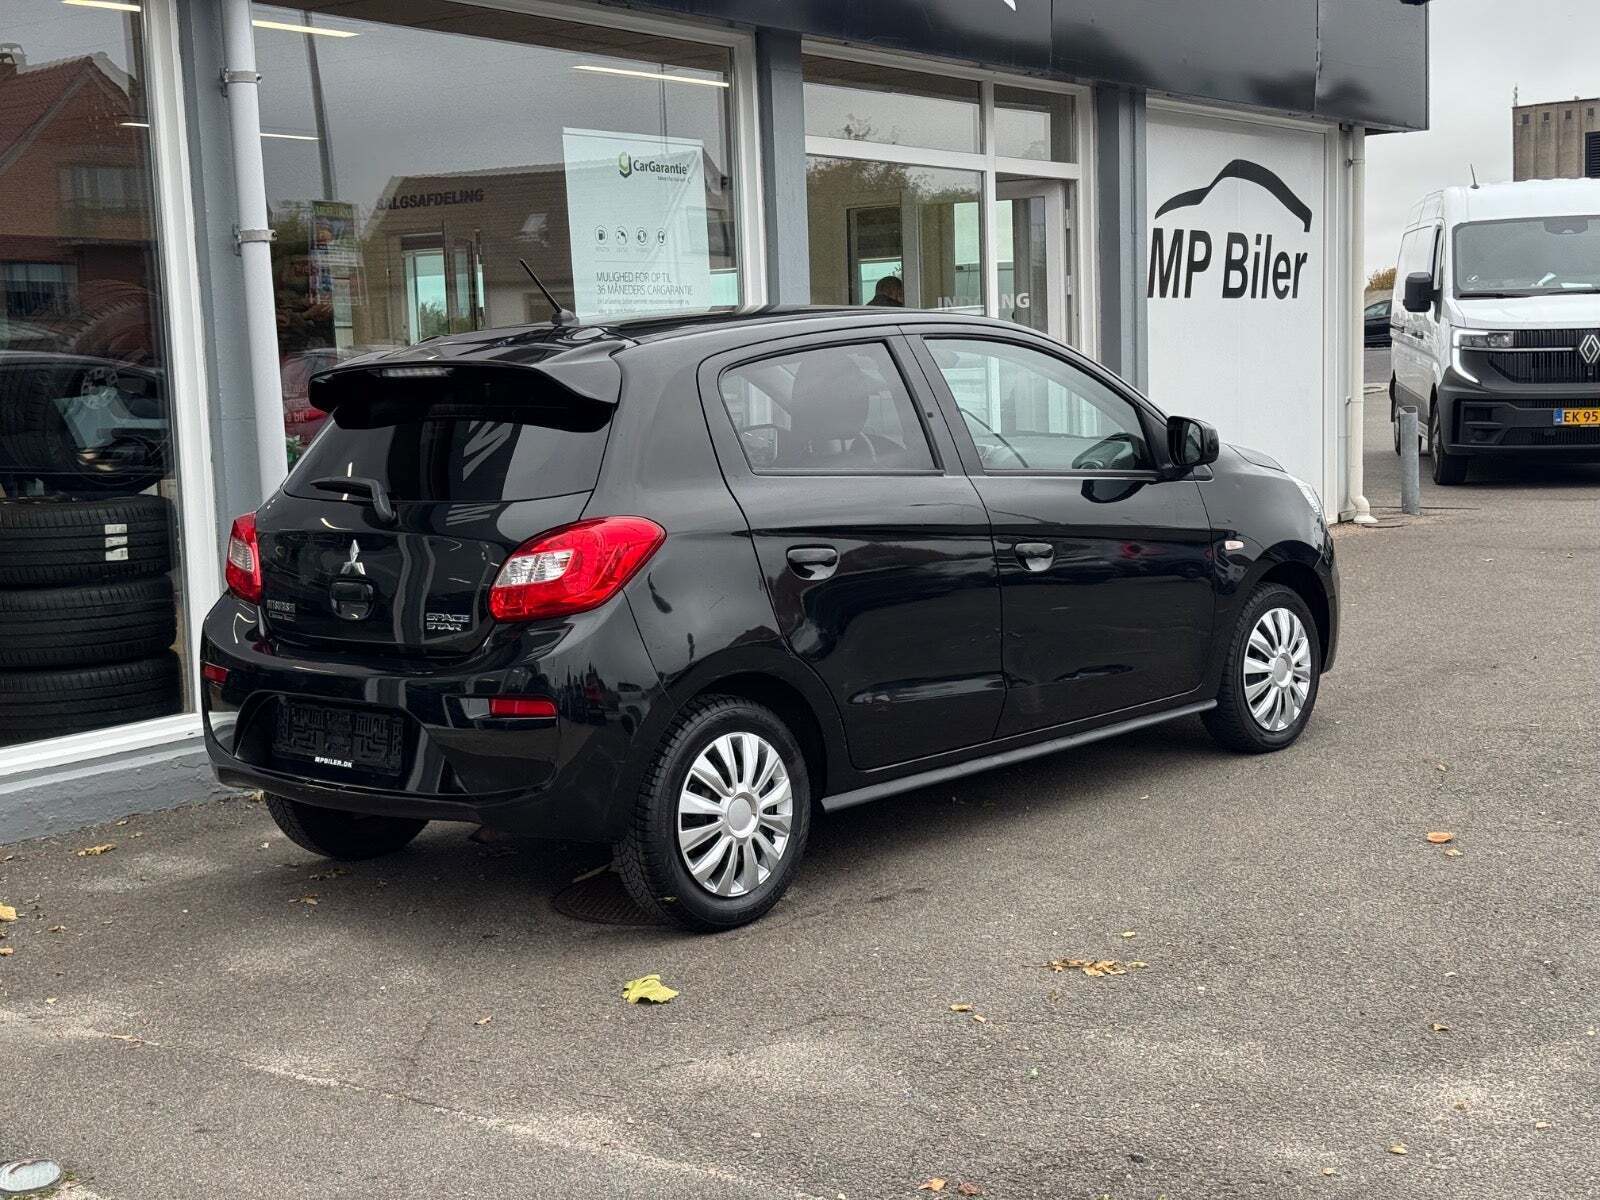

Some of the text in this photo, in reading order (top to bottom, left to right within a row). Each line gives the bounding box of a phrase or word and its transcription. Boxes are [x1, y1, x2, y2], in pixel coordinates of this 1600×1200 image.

[633, 159, 688, 175] CarGarantie
[1147, 228, 1308, 300] MP Biler
[596, 272, 634, 284] MULIGHED
[596, 285, 606, 296] 36
[1563, 411, 1599, 423] EK 95
[426, 613, 471, 622] SPACE
[426, 622, 462, 632] STAR
